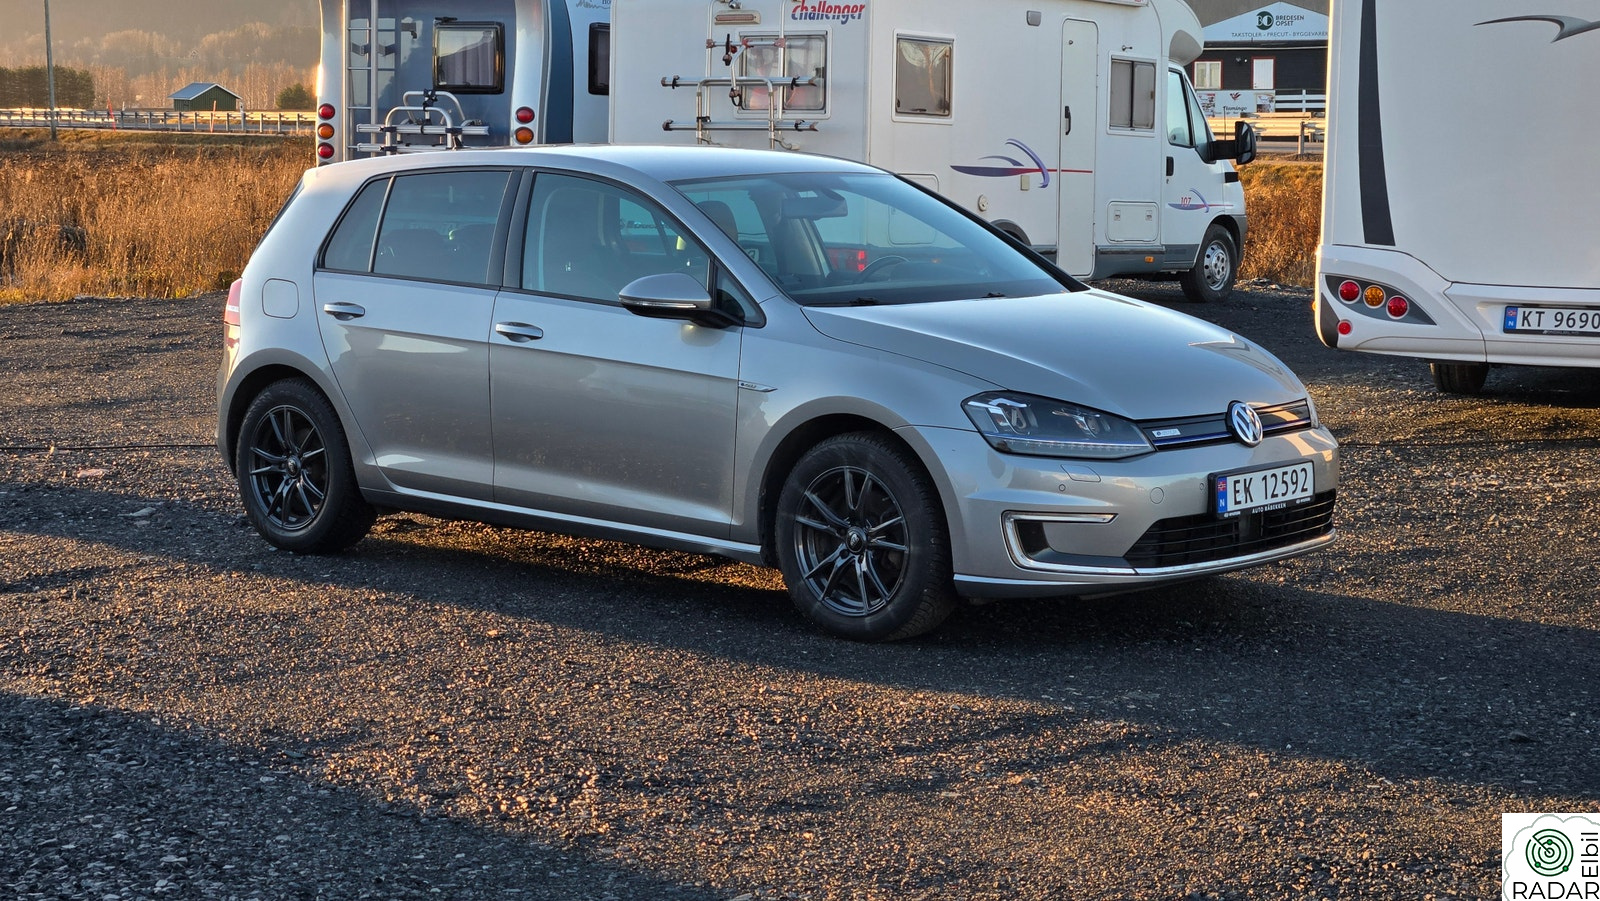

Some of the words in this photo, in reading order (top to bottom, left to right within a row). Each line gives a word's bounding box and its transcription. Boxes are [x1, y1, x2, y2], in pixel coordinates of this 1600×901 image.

[791, 0, 865, 25] Challenger
[1521, 310, 1545, 327] KT
[1233, 477, 1254, 506] EK
[1261, 467, 1309, 500] 12592
[1219, 498, 1225, 507] N
